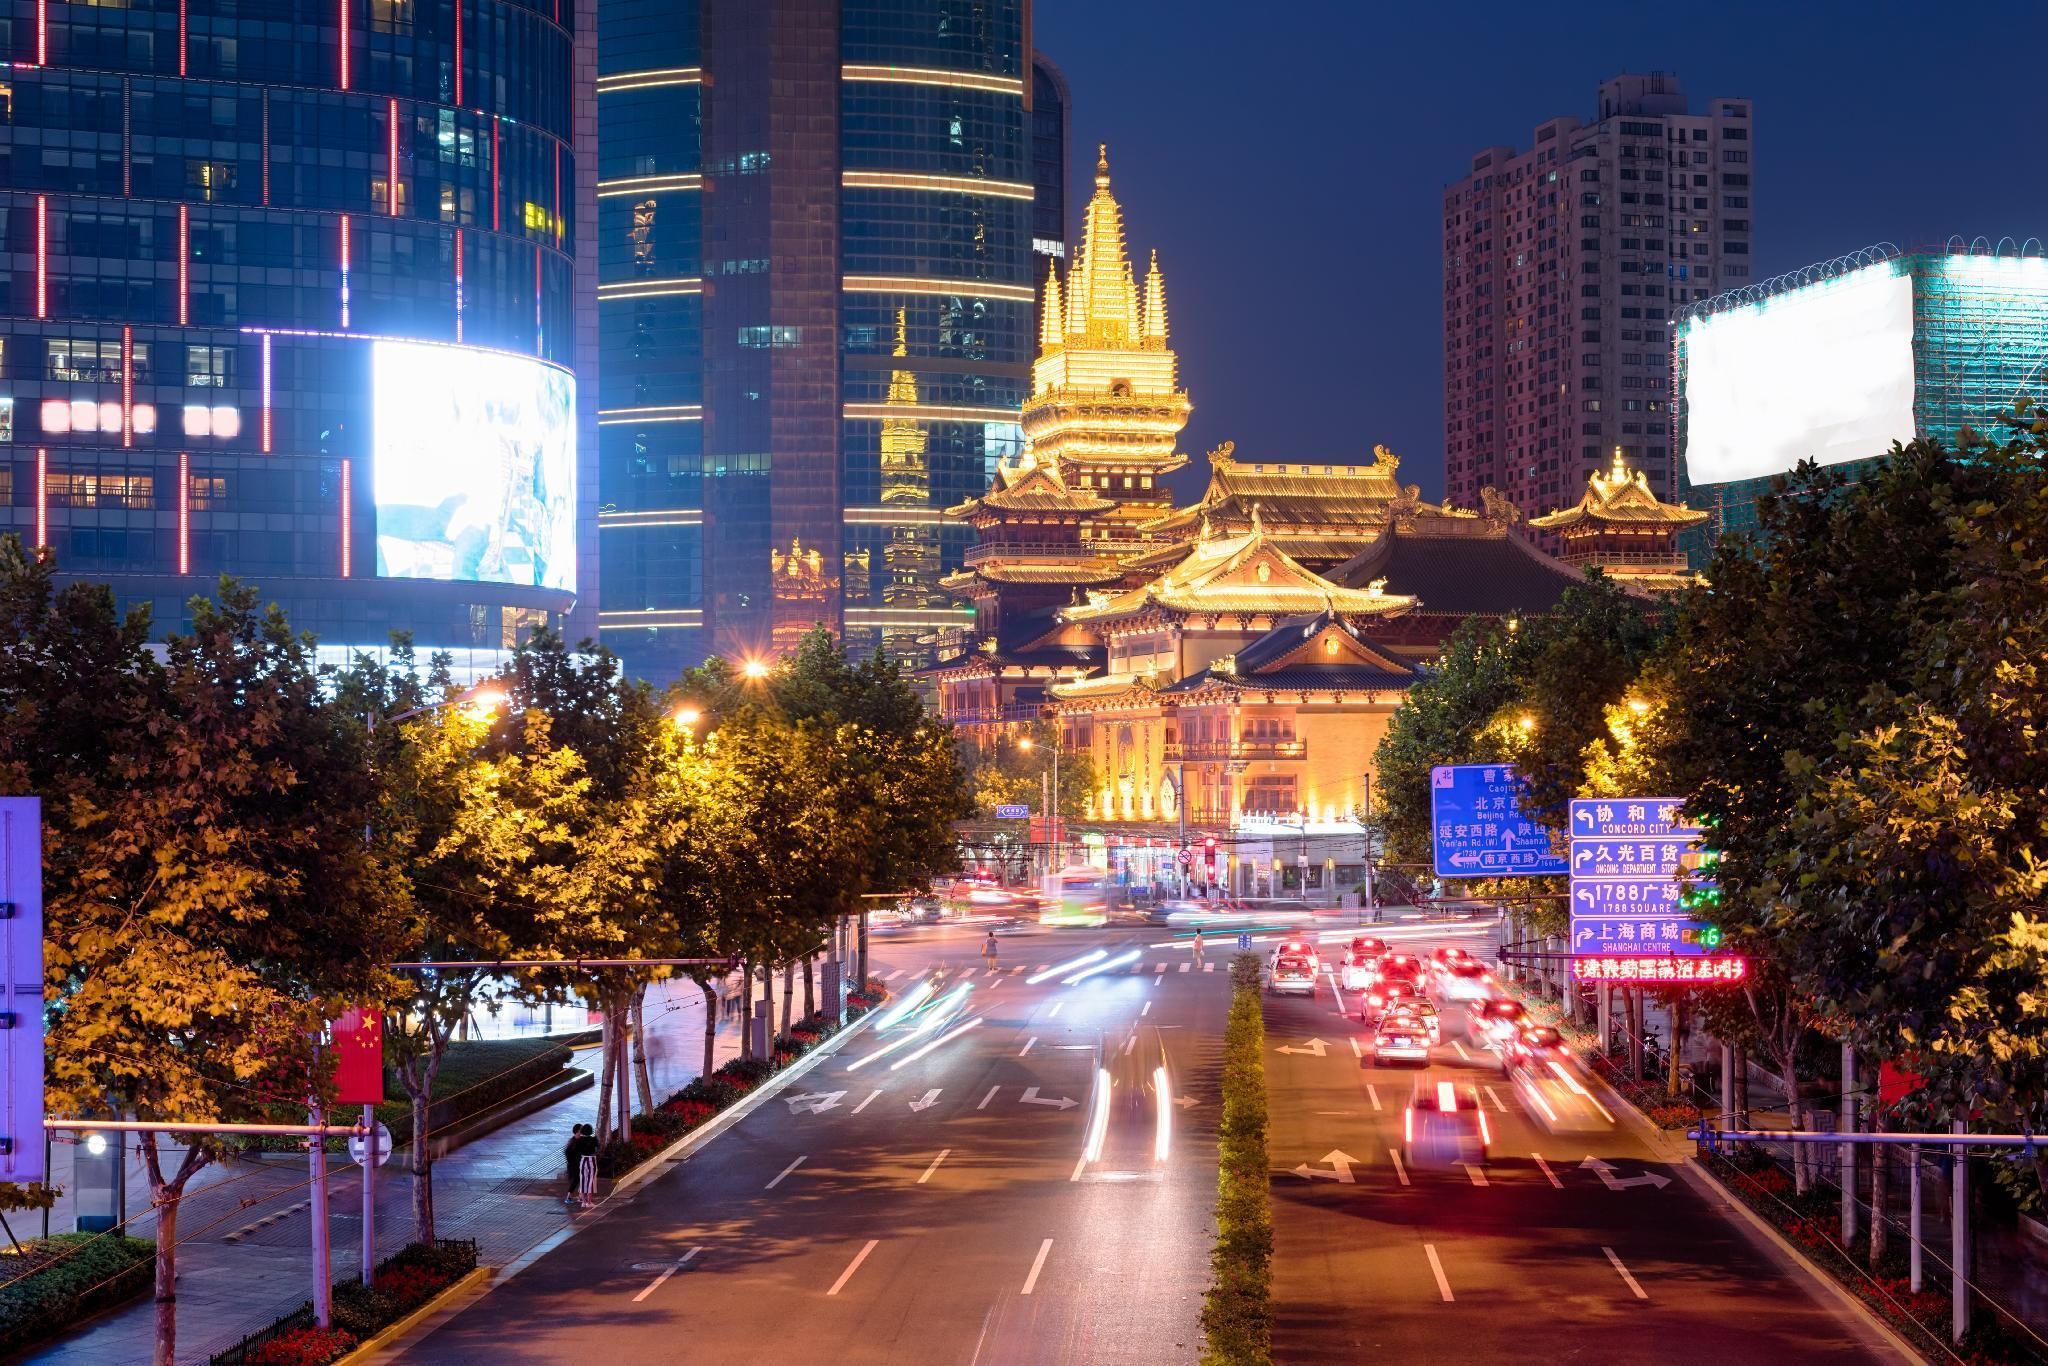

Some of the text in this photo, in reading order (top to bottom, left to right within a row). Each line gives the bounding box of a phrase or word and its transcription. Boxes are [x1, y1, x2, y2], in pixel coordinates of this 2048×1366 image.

[1442, 770, 1452, 780] 北
[1475, 797, 1531, 810] 北京西
[1477, 811, 1504, 821] Beijing
[1596, 804, 1675, 822] 协和城
[1439, 823, 1498, 838] 延安西路
[1602, 824, 1671, 834] CONCORD CITY
[1440, 839, 1467, 848] Yan'an
[1516, 836, 1547, 845] Shaanxi
[1595, 844, 1678, 862] 久光百货
[1484, 853, 1535, 864] 南京西路
[1595, 864, 1678, 874] ONGOING DEPARTMENT STORE
[1595, 884, 1679, 902] 1788广场
[1603, 903, 1671, 913] 1788 SQUARE
[1597, 923, 1679, 940] 上海商城
[1602, 942, 1671, 952] SHANGHAI CENTRE
